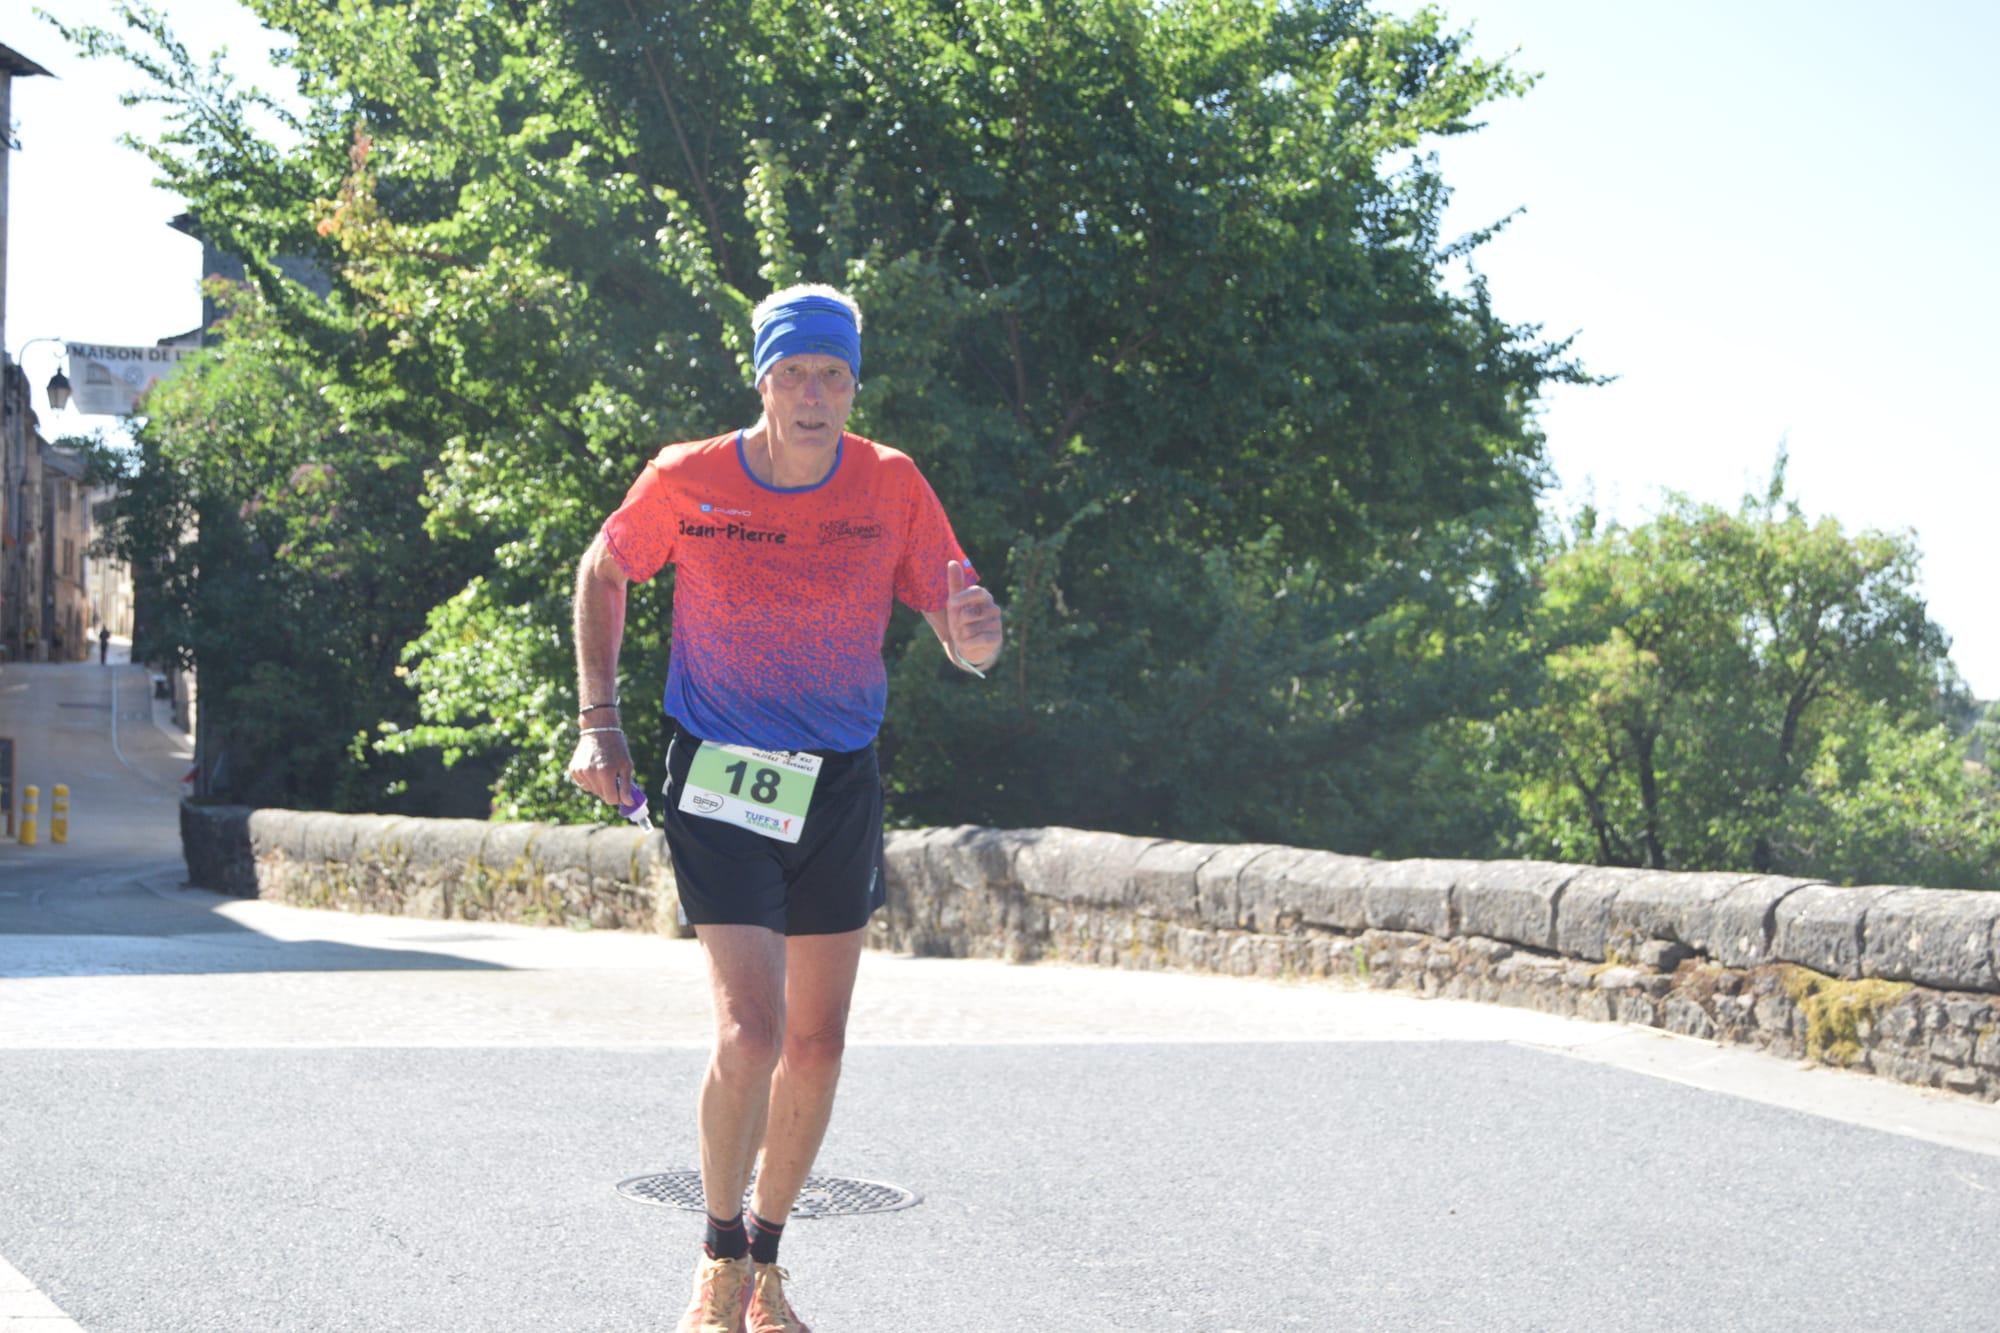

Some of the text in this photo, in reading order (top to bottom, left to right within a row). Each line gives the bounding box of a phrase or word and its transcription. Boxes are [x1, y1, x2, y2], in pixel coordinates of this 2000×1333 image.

[72, 345, 142, 361] MAISON
[149, 349, 171, 362] DE
[679, 520, 787, 544] Jean-Pierre
[725, 760, 781, 804] 18
